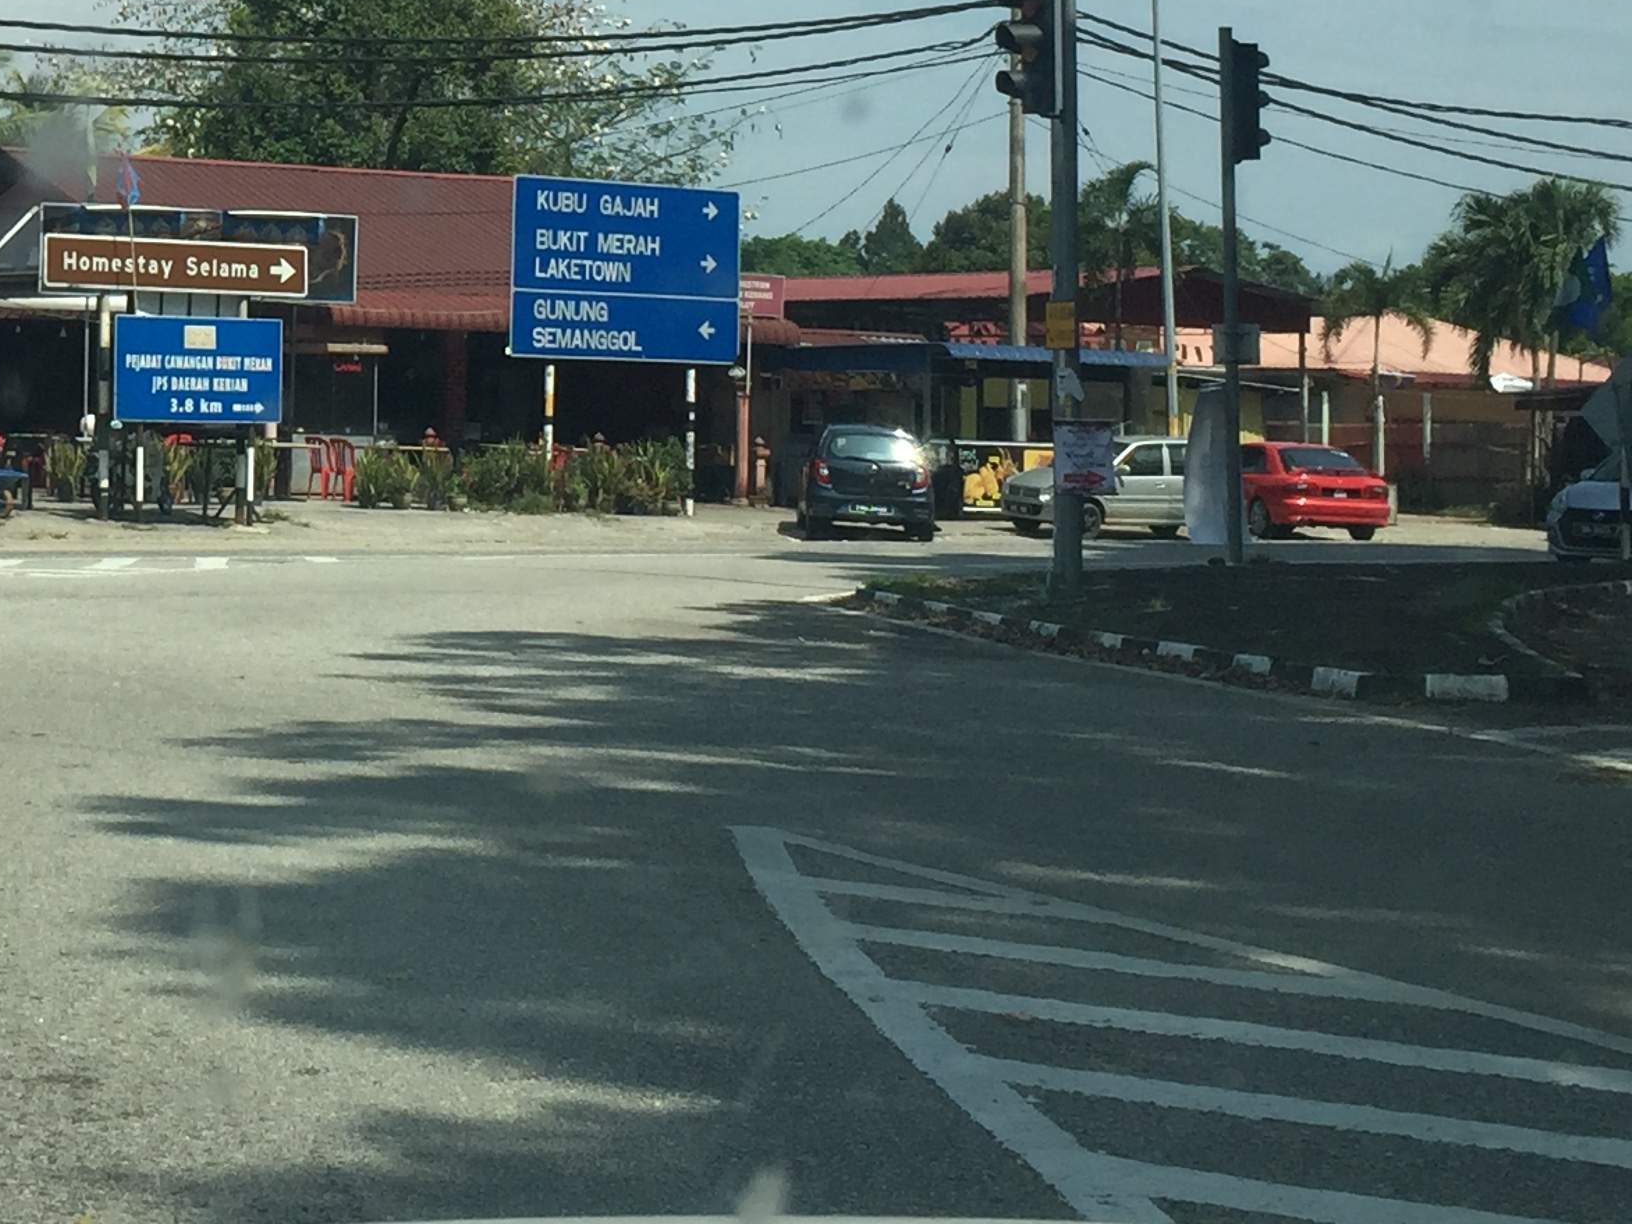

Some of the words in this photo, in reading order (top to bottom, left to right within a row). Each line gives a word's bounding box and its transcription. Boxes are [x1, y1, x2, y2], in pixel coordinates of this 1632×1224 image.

[536, 190, 588, 213] KUBU
[599, 195, 660, 218] GAJAH
[535, 229, 589, 253] BUKIT
[597, 234, 661, 256] MERAH
[63, 251, 173, 279] Homestay
[186, 256, 259, 279] Selama
[535, 257, 632, 282] LAKETOWN
[533, 299, 609, 322] GUNUNG
[532, 327, 642, 351] SEMANGGOL
[125, 354, 162, 372] PEJABAT
[164, 356, 214, 370] CAWANGAN
[216, 356, 242, 371] BUKIT
[151, 376, 168, 394] JPS
[171, 377, 210, 391] DAERAH
[213, 378, 248, 392] KERIAN
[170, 398, 194, 413] 3.8
[200, 398, 223, 413] km
